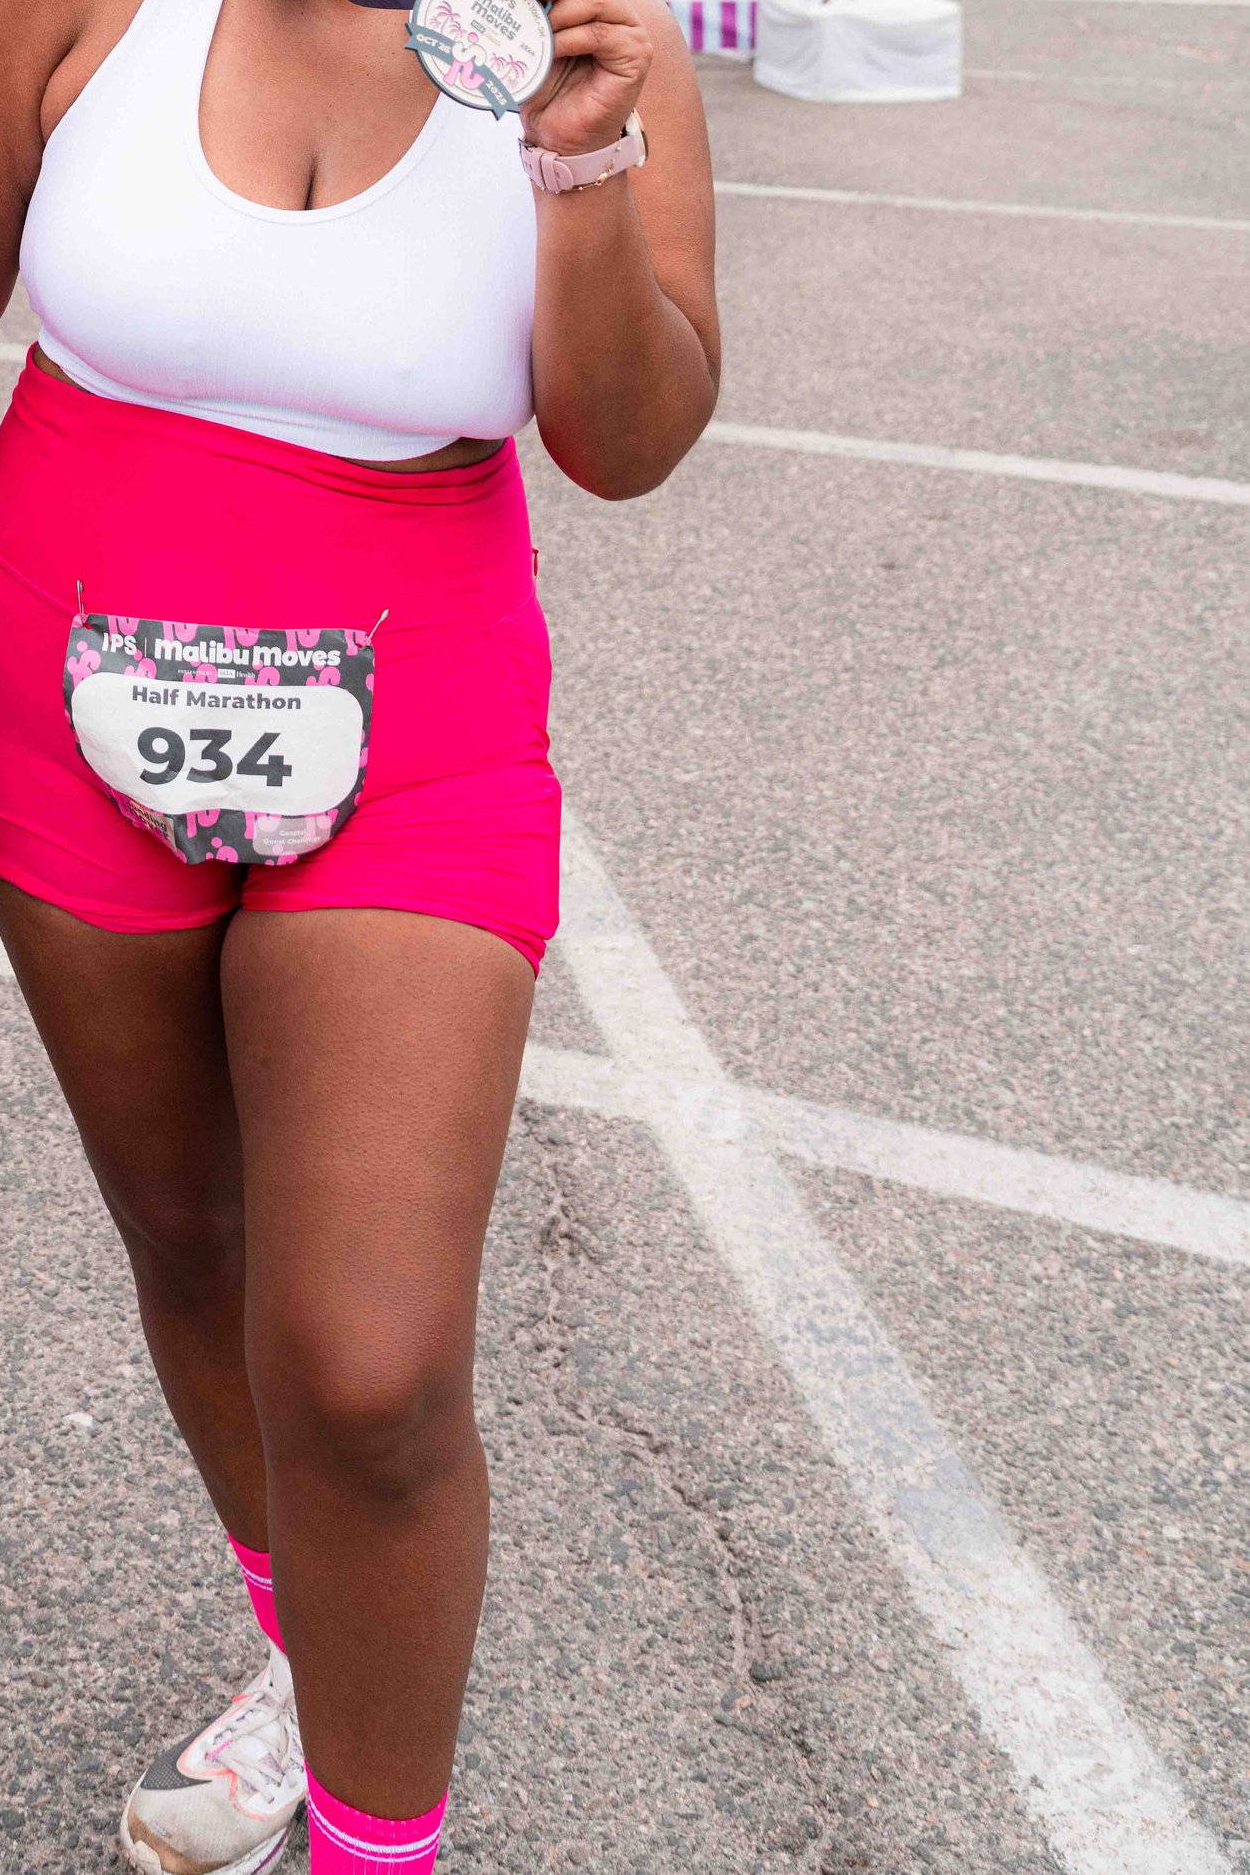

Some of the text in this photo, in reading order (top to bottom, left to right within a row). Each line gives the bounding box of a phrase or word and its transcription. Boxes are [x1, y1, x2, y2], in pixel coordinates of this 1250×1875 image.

[470, 1, 516, 40] moves
[416, 33, 438, 46] OCT
[485, 80, 507, 106] 2025
[102, 632, 342, 667] IPS malibu moves
[132, 685, 302, 710] Half Marathon
[137, 726, 293, 788] 934
